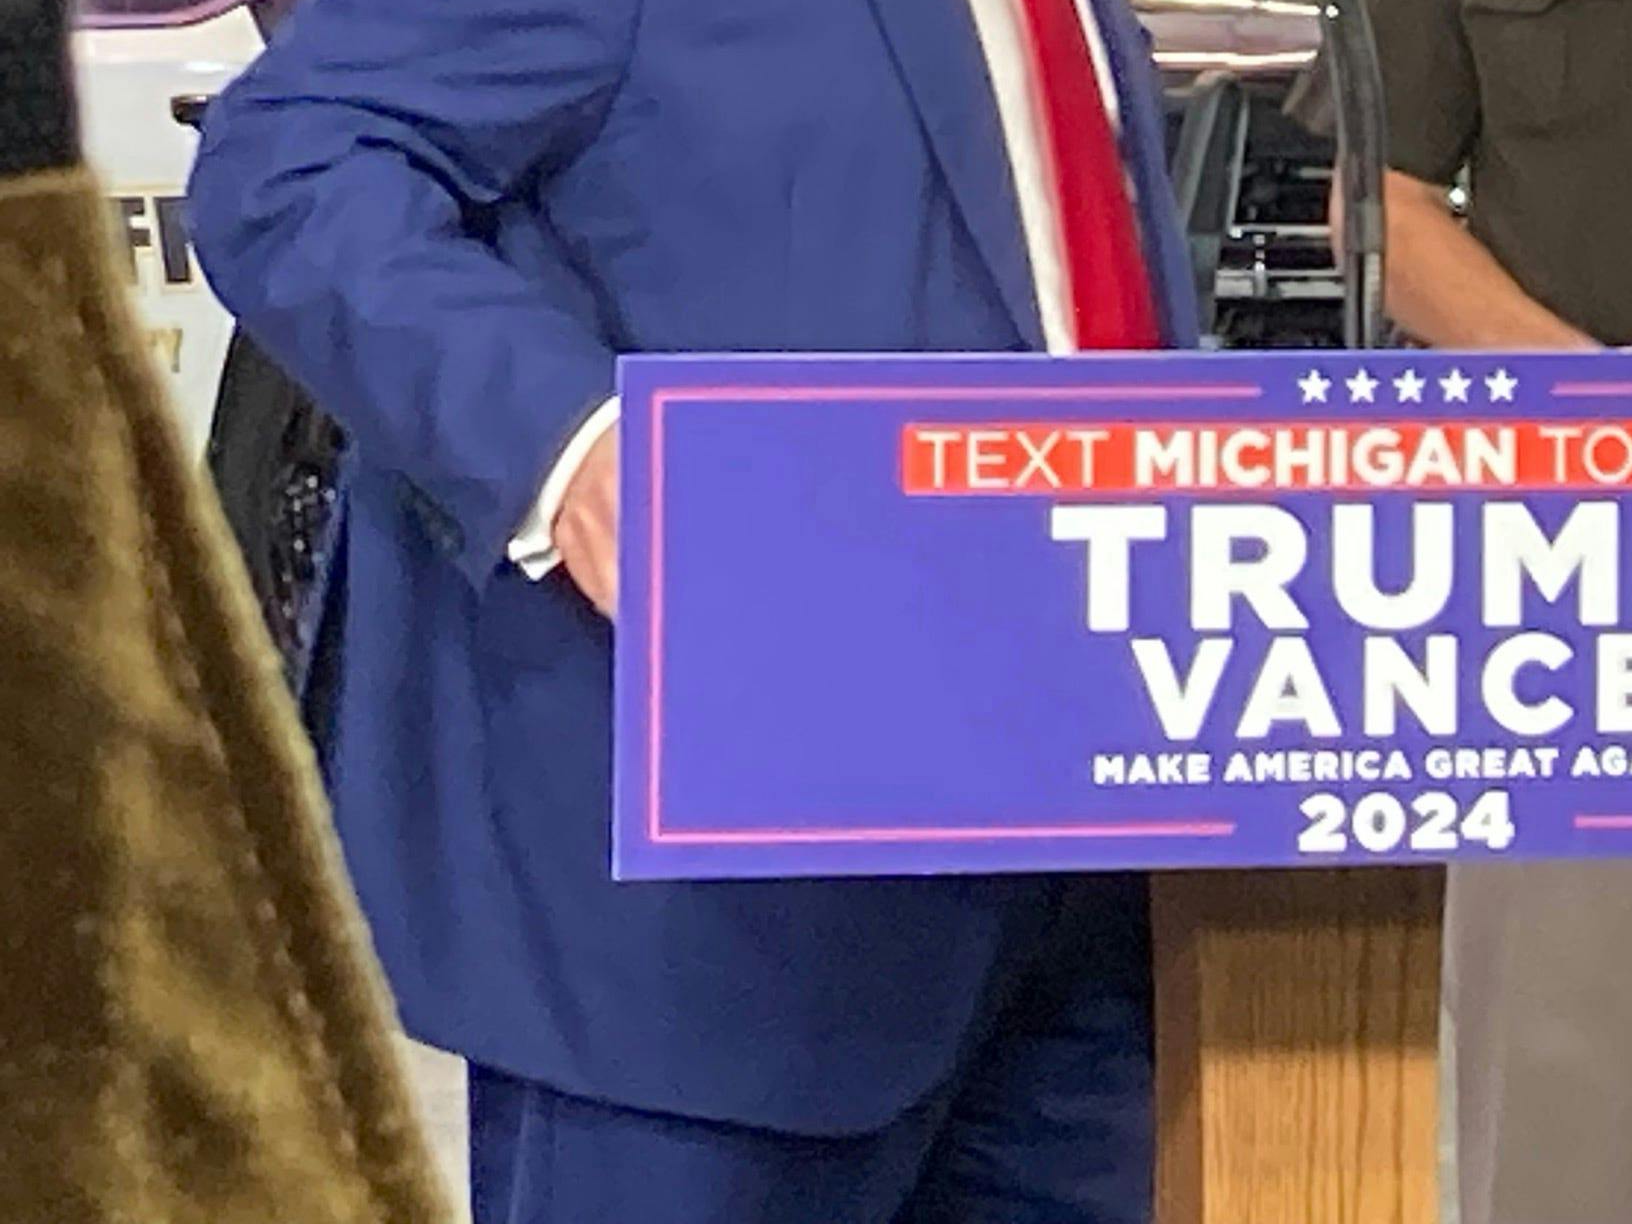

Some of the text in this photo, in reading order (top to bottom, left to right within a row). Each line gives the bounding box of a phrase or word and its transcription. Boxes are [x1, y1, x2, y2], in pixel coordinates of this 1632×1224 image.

[915, 430, 1109, 489] TEXT
[1134, 426, 1517, 488] MICHIGAN
[1092, 752, 1211, 786] MAKE
[1223, 749, 1413, 783] AMERICA
[1424, 747, 1560, 780] GREAT
[1297, 790, 1516, 853] 2024
